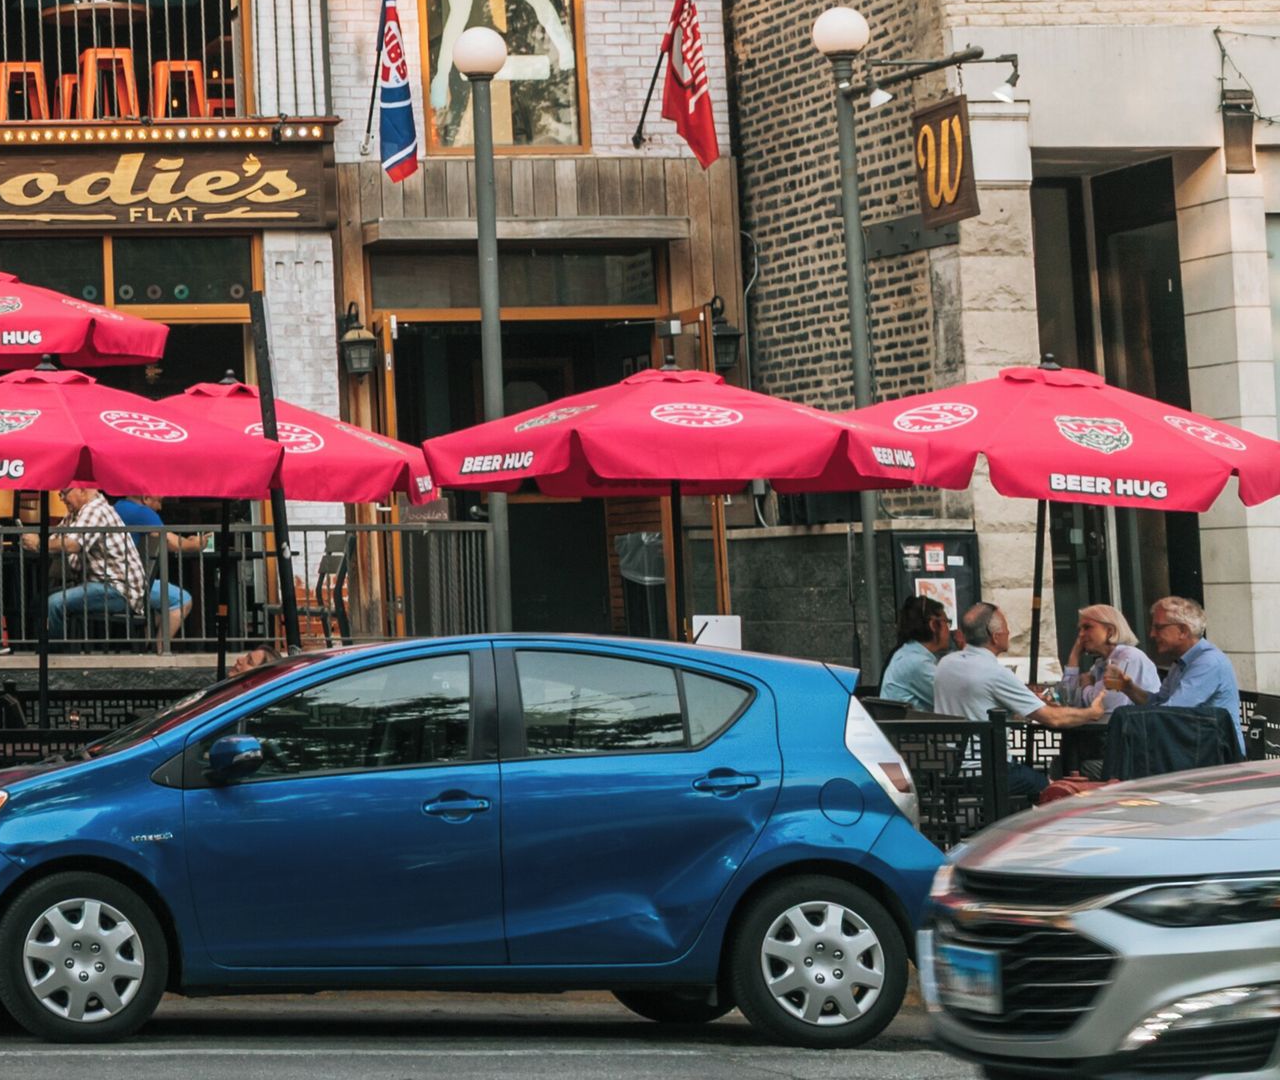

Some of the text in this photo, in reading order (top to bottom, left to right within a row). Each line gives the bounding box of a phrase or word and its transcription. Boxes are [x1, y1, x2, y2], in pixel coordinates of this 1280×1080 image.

[917, 113, 963, 208] W
[129, 206, 198, 223] FLAT
[3, 331, 42, 345] HUG
[461, 451, 534, 474] BEER HUG
[1050, 473, 1168, 499] BEER HUG
